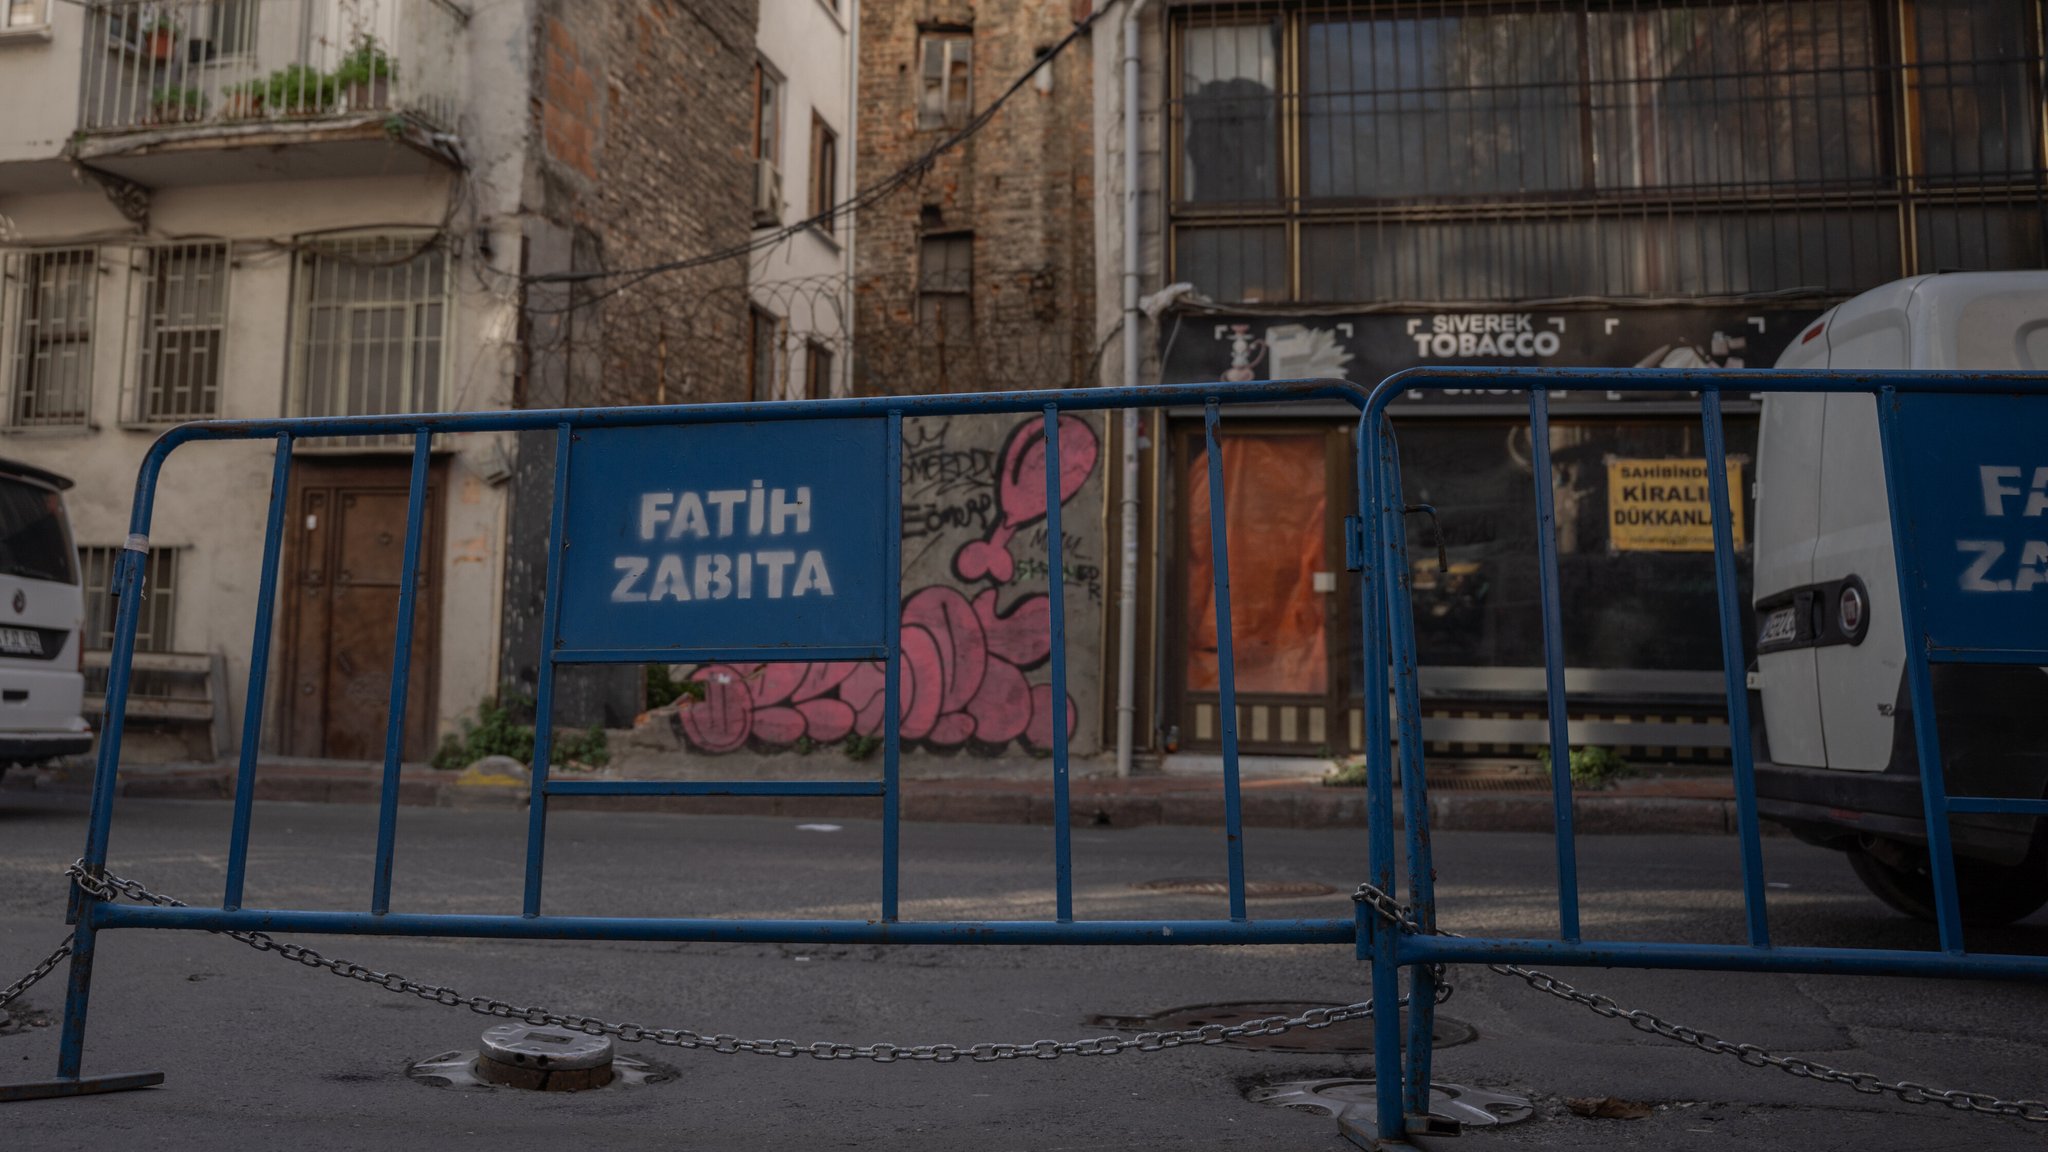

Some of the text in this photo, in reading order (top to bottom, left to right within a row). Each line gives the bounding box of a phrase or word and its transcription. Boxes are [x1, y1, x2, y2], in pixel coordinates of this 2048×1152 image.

[1413, 331, 1560, 357] TOBACCO
[640, 479, 811, 540] FATİH
[1623, 482, 1709, 502] KİRALI
[611, 550, 834, 602] ZABITA
